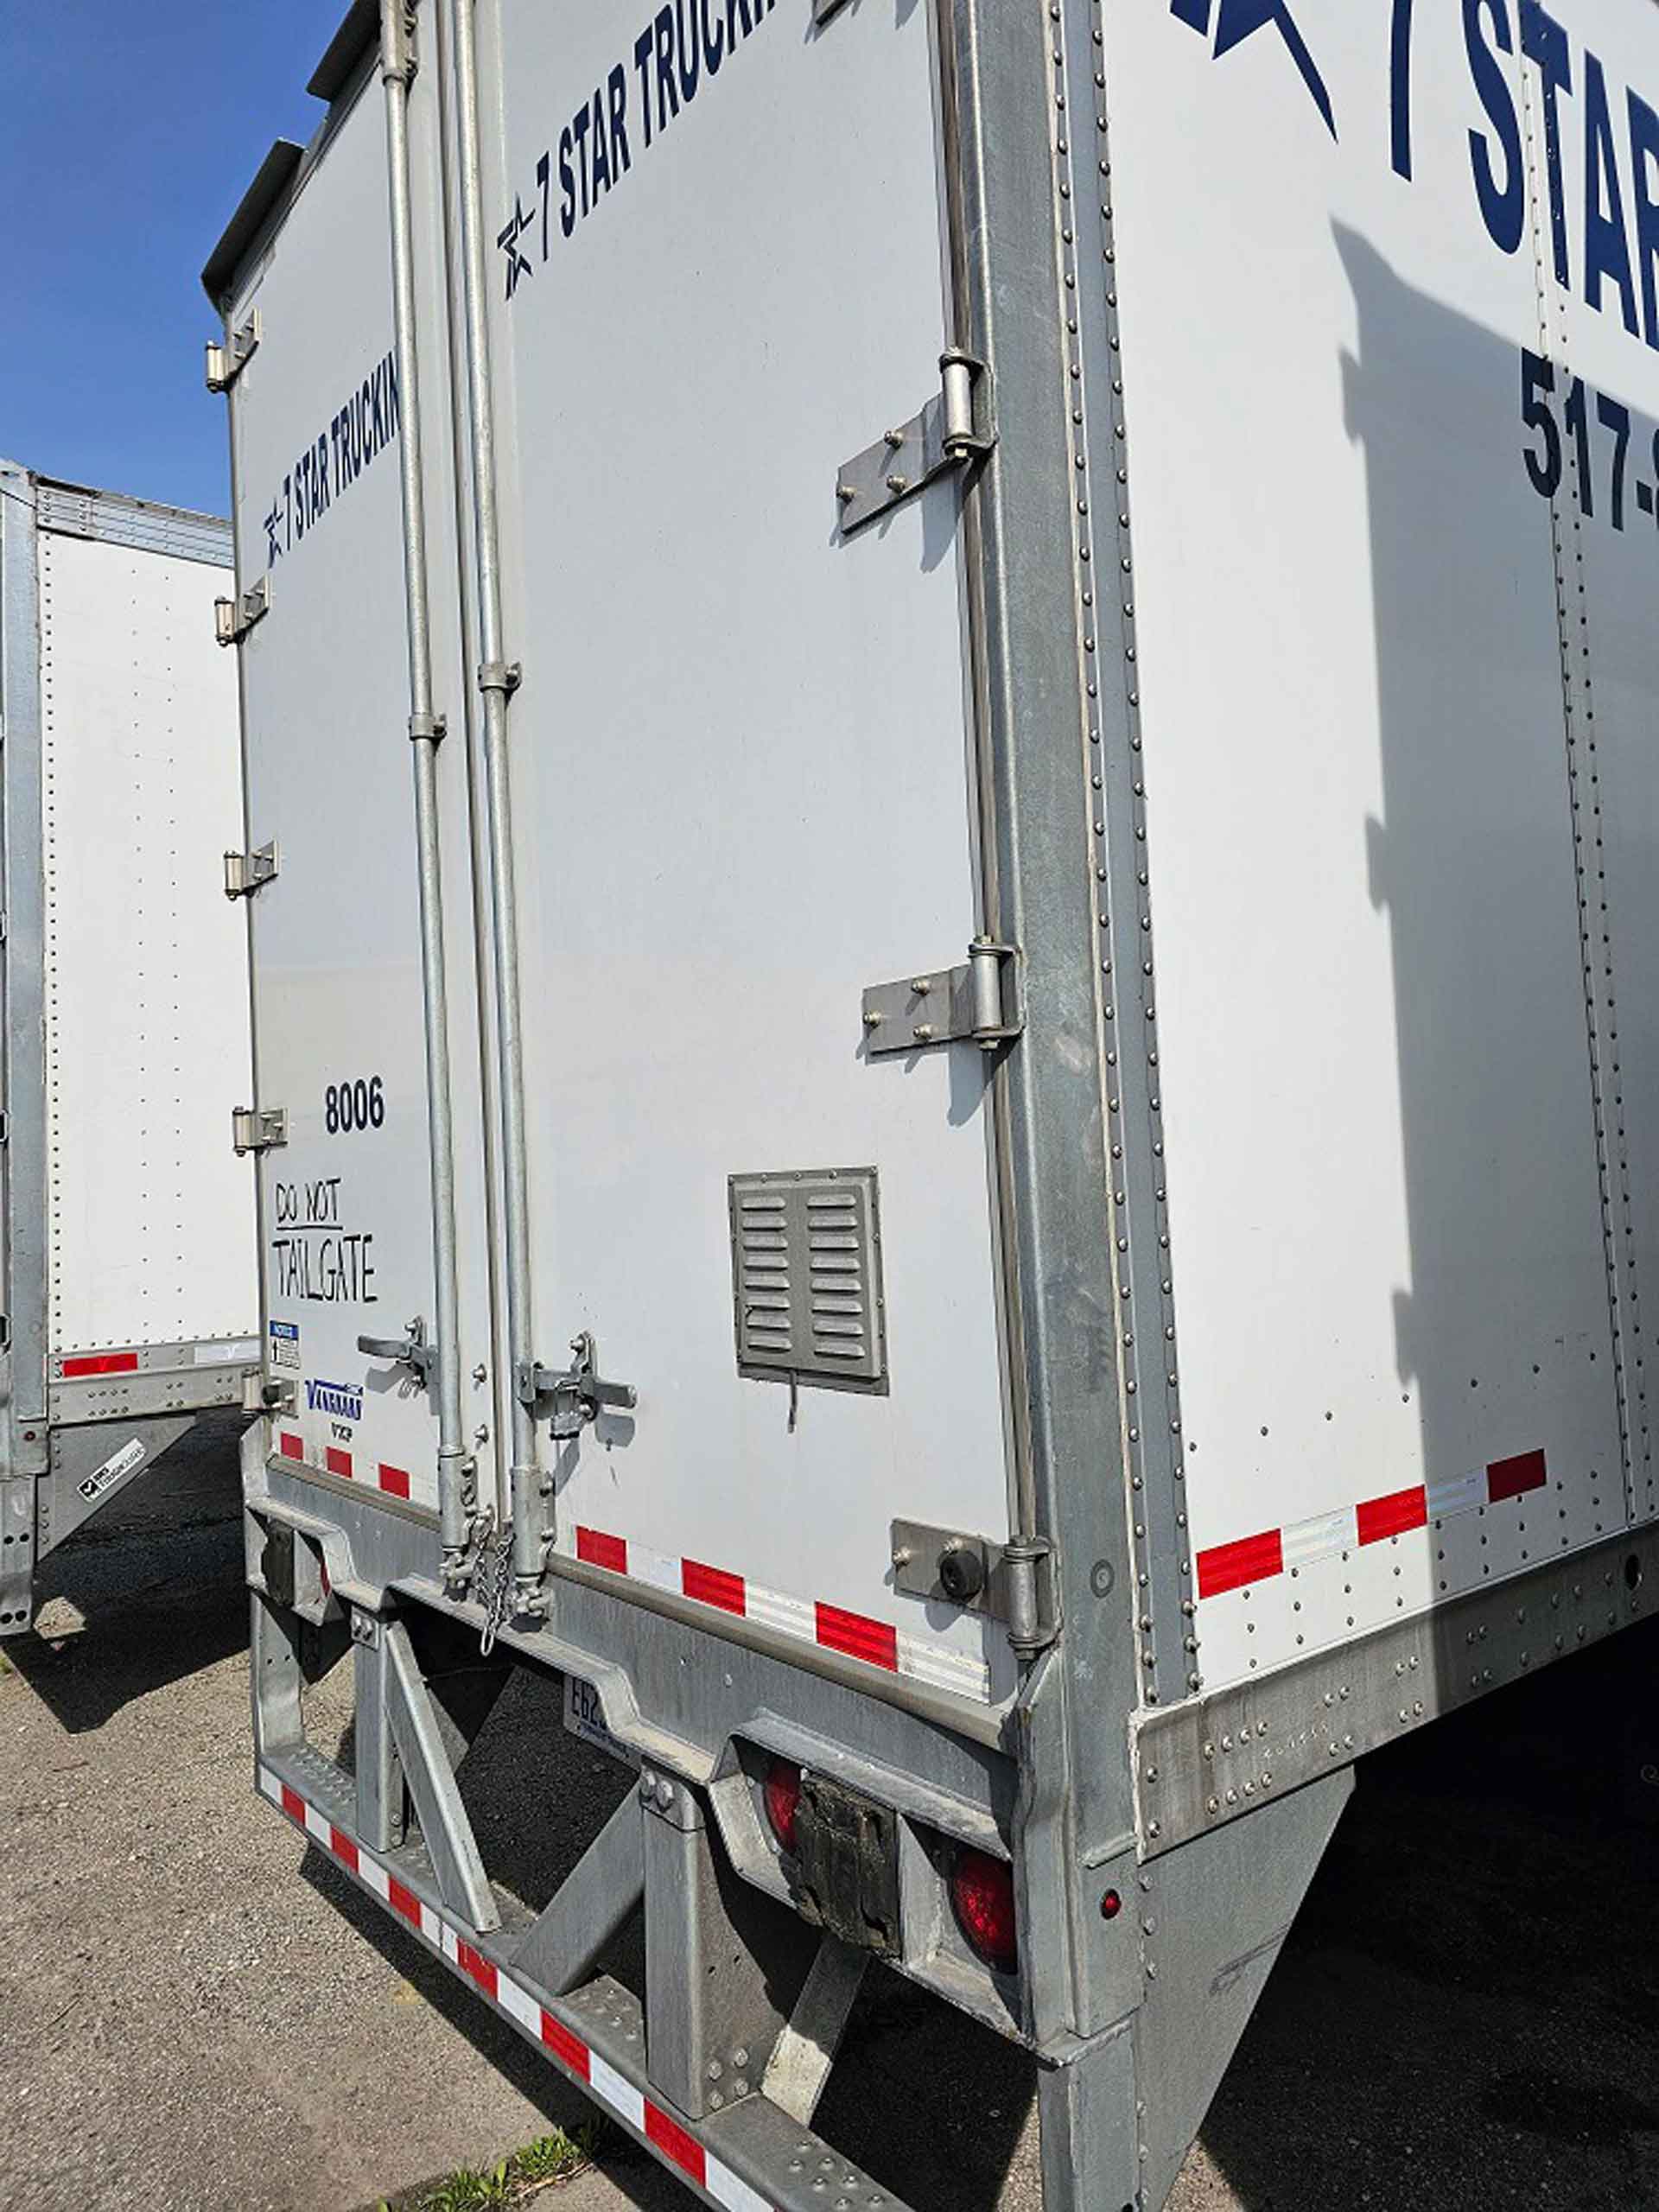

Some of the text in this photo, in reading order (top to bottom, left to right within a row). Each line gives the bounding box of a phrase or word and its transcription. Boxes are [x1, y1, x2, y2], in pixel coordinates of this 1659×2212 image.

[537, 0, 775, 262] 7 STAR TRUC
[1461, 0, 1659, 353] STAR
[295, 432, 330, 539] STAR
[1521, 346, 1659, 532] 517-
[326, 1075, 385, 1135] 8006
[276, 1178, 341, 1223] DO NOT
[272, 1233, 378, 1303] TAILGATE
